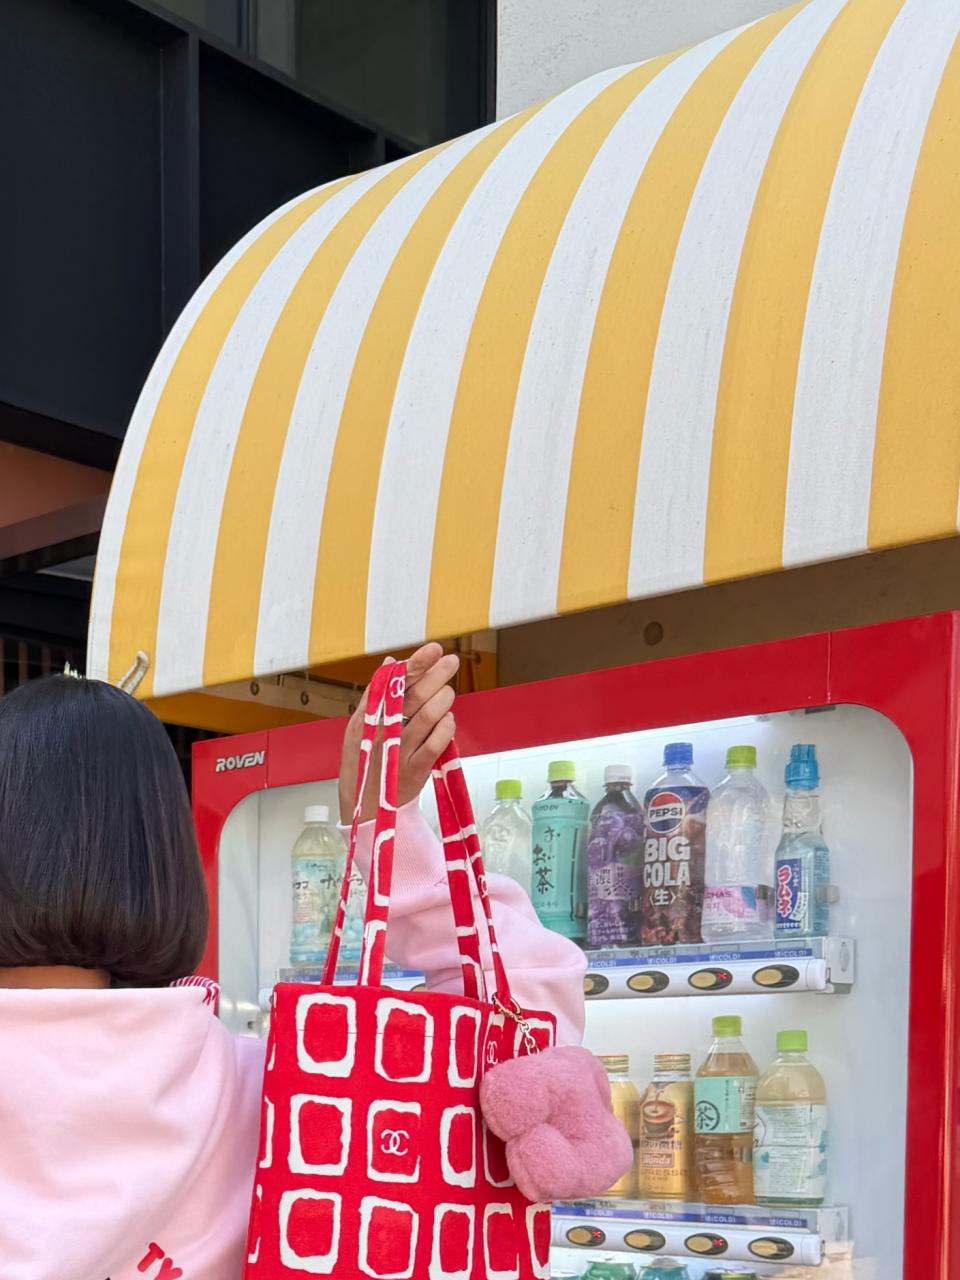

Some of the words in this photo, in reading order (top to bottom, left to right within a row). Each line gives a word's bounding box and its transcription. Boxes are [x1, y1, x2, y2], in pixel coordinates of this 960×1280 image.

[215, 750, 266, 773] ROVEN
[648, 806, 683, 819] PEPSI
[644, 835, 691, 862] BIG
[643, 861, 692, 889] COLA
[777, 864, 792, 918] ラムネ
